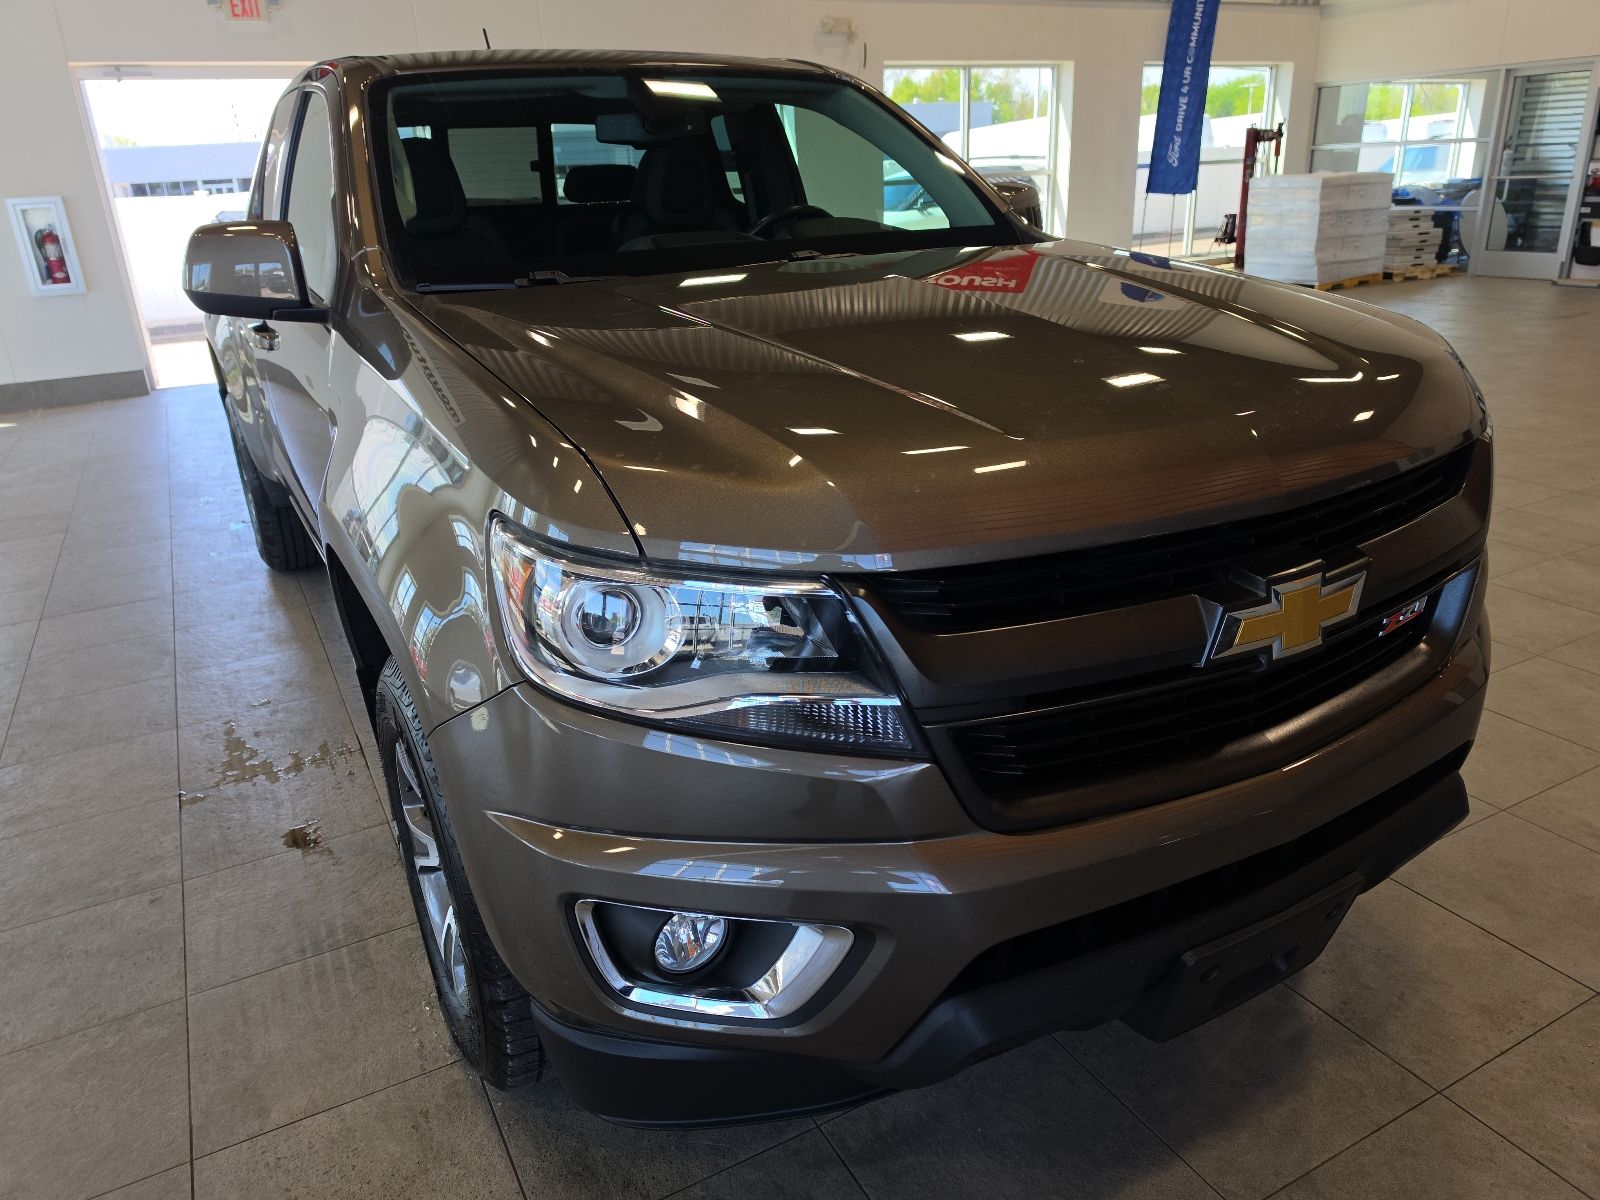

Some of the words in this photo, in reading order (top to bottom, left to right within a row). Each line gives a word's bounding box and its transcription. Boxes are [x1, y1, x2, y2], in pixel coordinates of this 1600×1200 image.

[229, 0, 261, 17] EXIT
[1182, 66, 1192, 84] UR
[1180, 85, 1190, 94] 4
[1175, 96, 1189, 132] DRIVE
[1167, 135, 1182, 168] Ford
[1379, 596, 1428, 637] Z71
